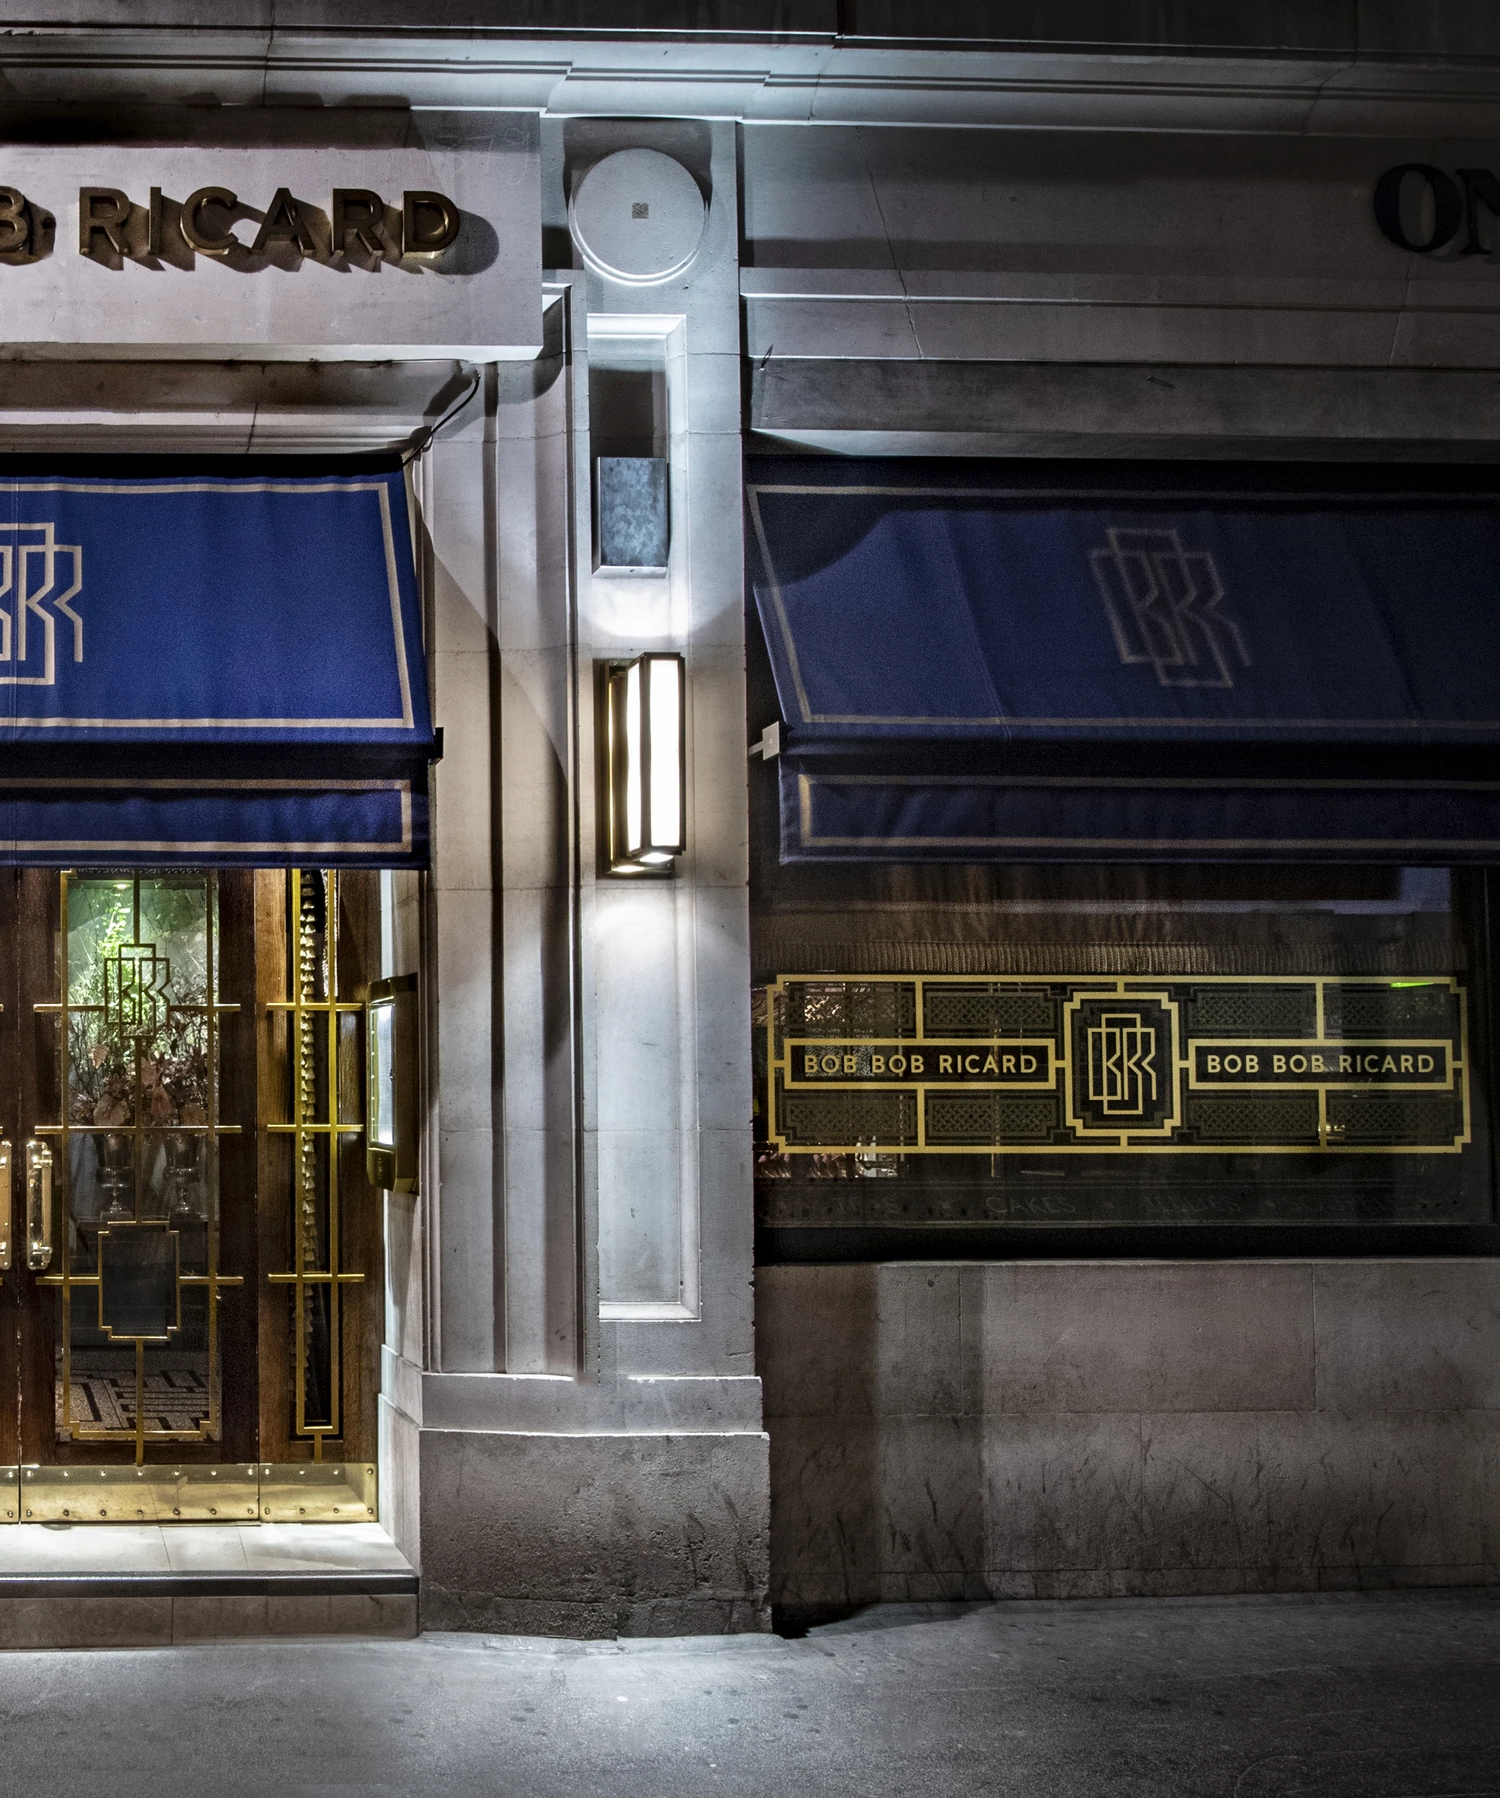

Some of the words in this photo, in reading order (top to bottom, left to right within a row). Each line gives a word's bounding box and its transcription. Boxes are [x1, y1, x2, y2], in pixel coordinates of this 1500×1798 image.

[79, 186, 460, 258] RICARD
[804, 1054, 857, 1074] BOB
[871, 1054, 925, 1074] BOB
[939, 1054, 1038, 1074] RICARD
[1207, 1054, 1259, 1073] BOB
[1273, 1054, 1325, 1073] BOB
[1339, 1054, 1435, 1073] RICARD
